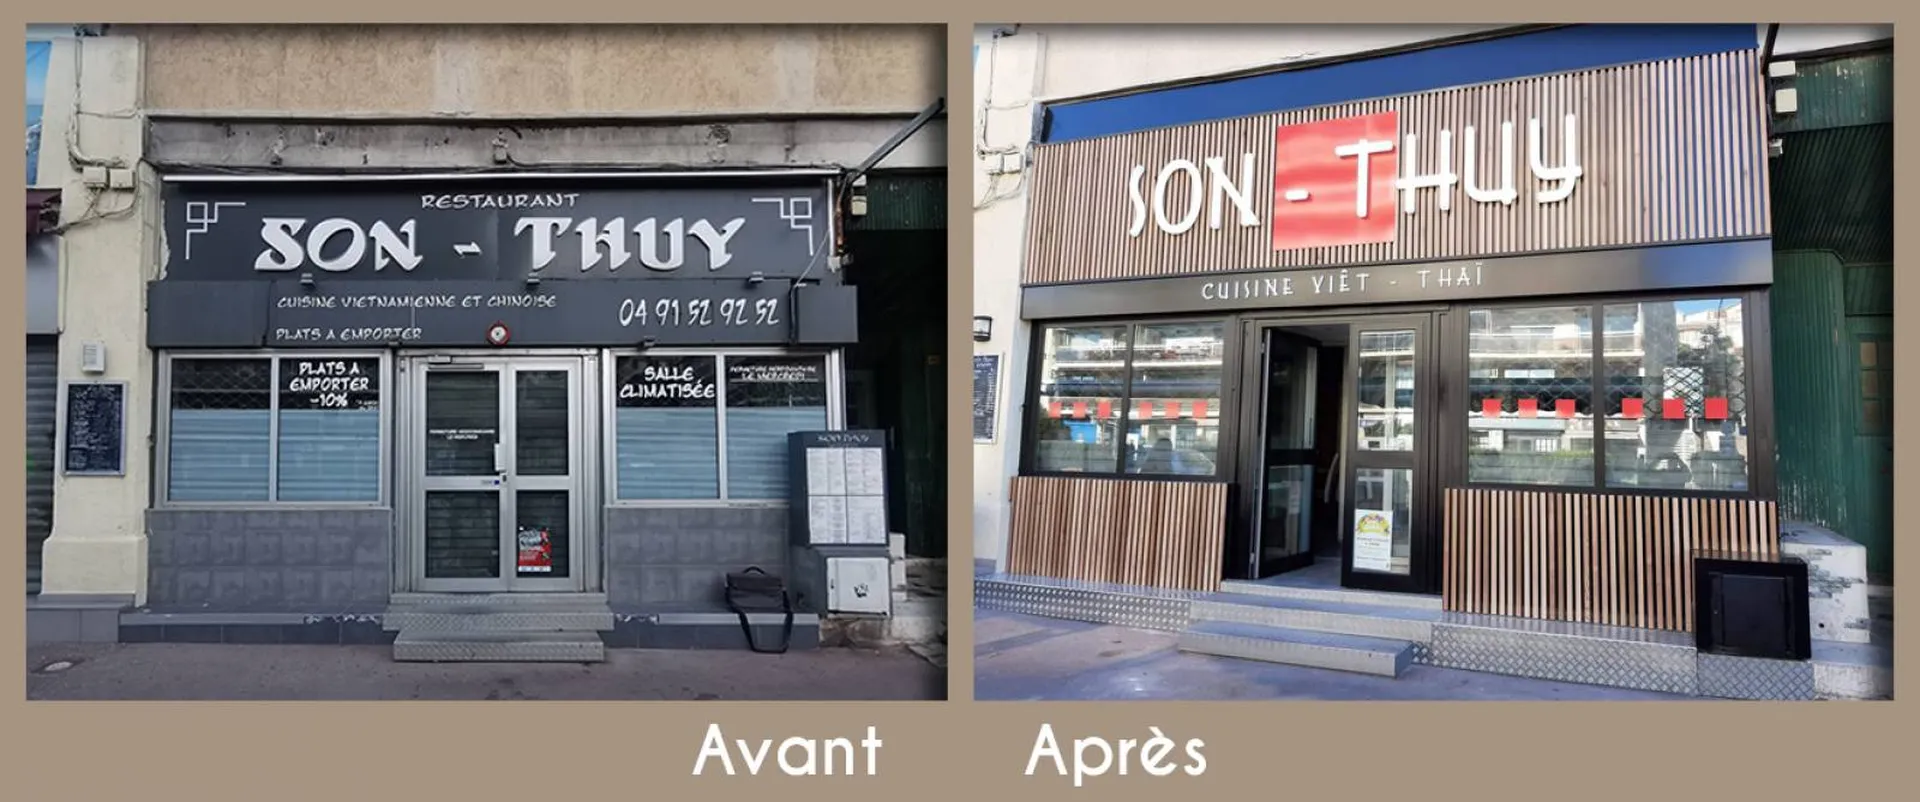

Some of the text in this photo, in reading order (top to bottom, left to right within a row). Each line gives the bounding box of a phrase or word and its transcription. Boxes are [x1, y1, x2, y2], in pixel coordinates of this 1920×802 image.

[1128, 152, 1261, 238] SON
[1334, 113, 1583, 218] THUY
[421, 193, 580, 209] RESTAURANT
[254, 217, 423, 272] SON
[513, 216, 746, 272] THUY
[1201, 277, 1294, 300] CUISINE
[1416, 262, 1483, 288] THAÏ
[277, 294, 557, 309] CUISINE VIETNAMIENNE ET CHINOISE
[619, 298, 780, 326] 04 91 52 92 52
[276, 327, 422, 341] PLATS A EMPORTER
[299, 361, 360, 376] PLATS A
[644, 366, 694, 381] SALLE
[289, 376, 369, 392] EMPORTER
[619, 378, 715, 399] CLIMATISÉE
[310, 392, 348, 407] -10%
